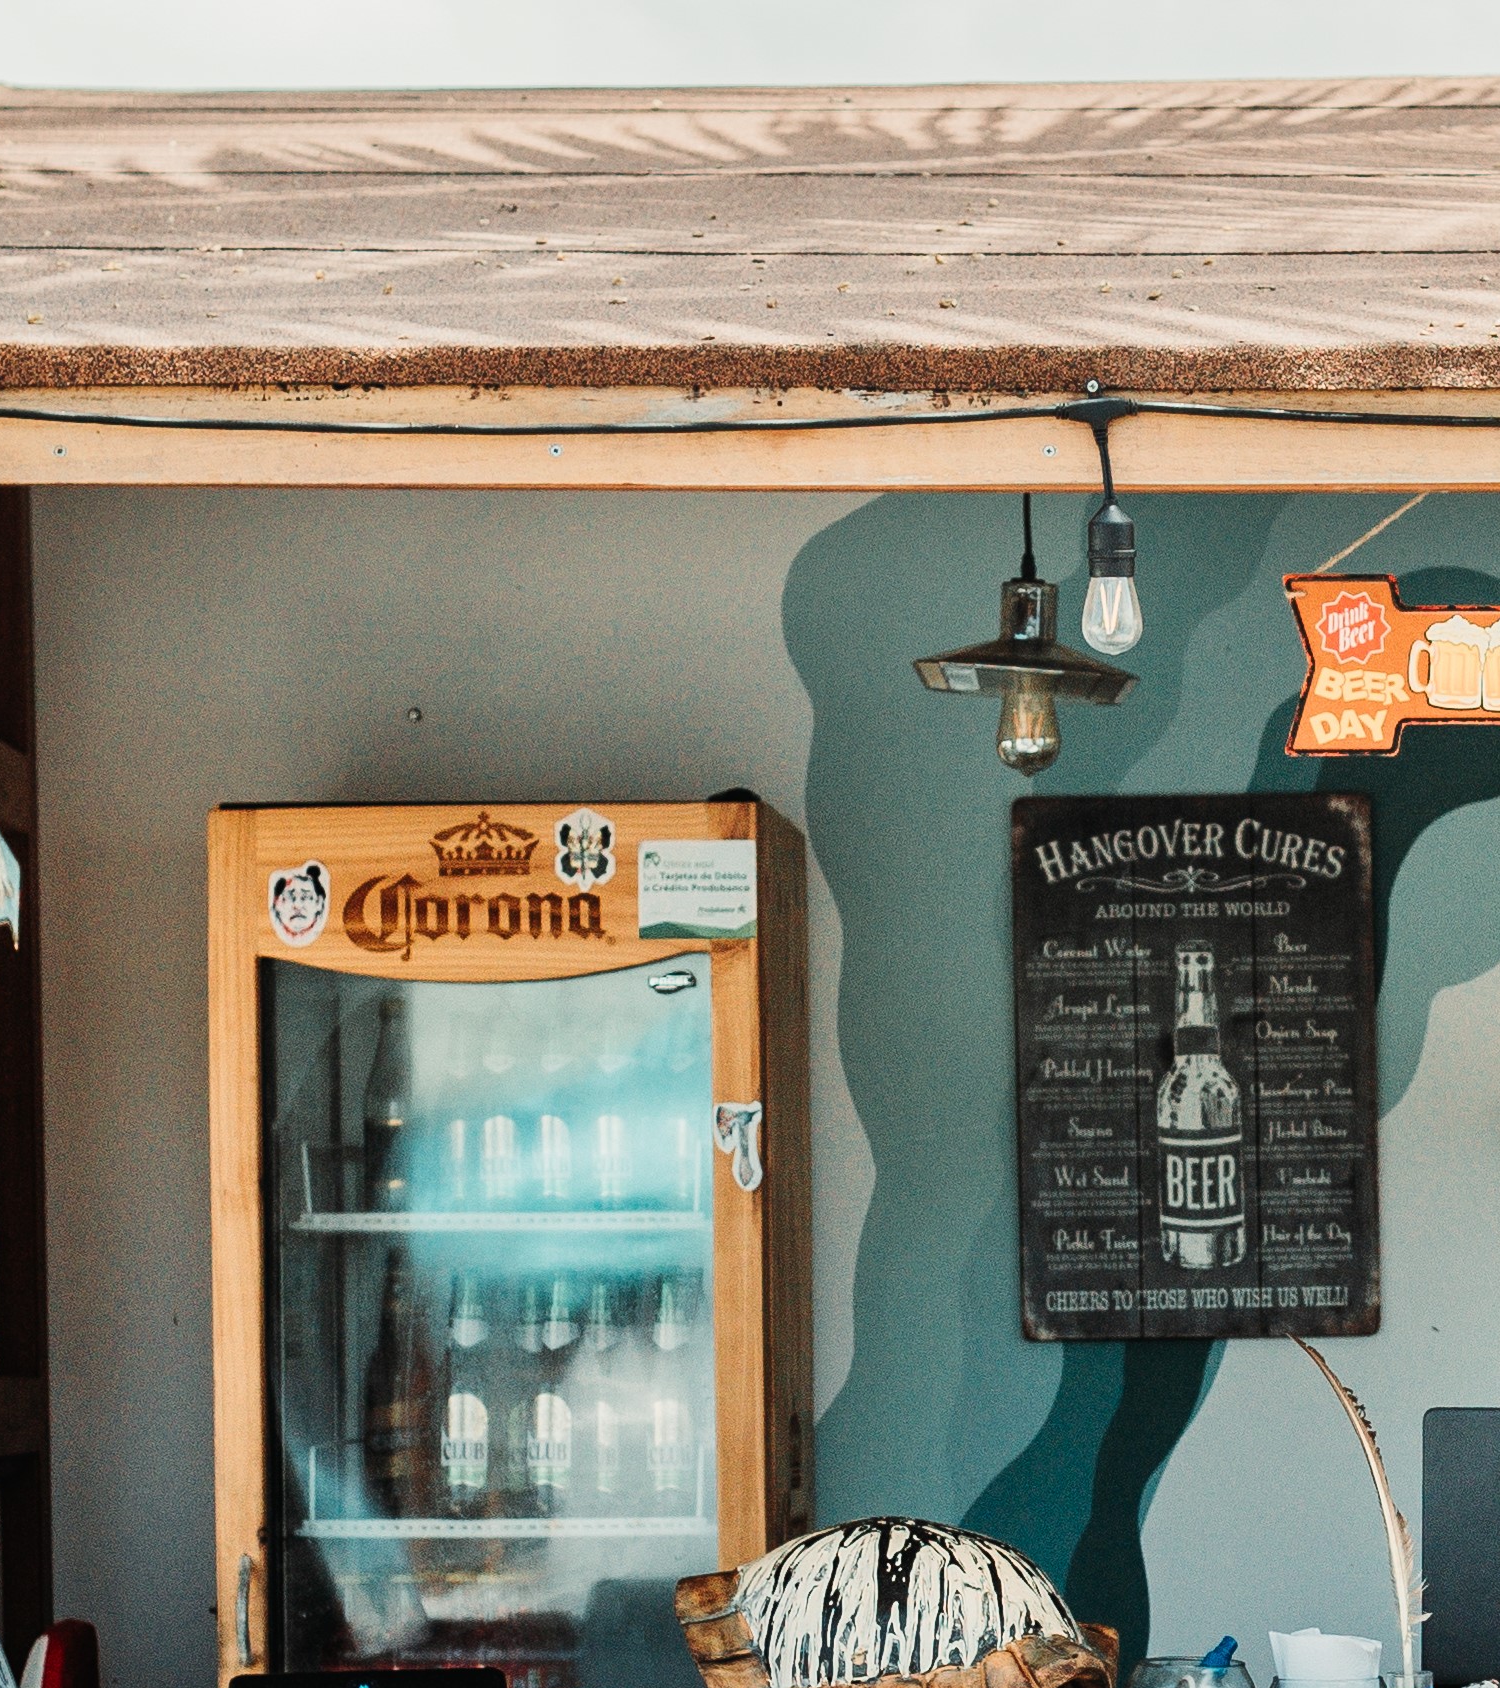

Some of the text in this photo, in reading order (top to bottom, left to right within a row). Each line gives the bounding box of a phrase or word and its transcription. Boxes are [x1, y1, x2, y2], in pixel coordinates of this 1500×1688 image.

[1327, 604, 1370, 635] Drink
[1338, 618, 1376, 653] Beer
[1314, 667, 1410, 705] BEER
[1309, 708, 1388, 745] DAY
[1035, 818, 1346, 883] HANGOVER CURES
[342, 871, 606, 961] Corona
[1095, 901, 1290, 920] AROUND THE WORLD
[1166, 1154, 1236, 1210] BEER
[1046, 1290, 1109, 1311] CHEERS
[1112, 1290, 1133, 1310] TO
[1136, 1289, 1187, 1310] THOSE
[1191, 1288, 1228, 1309] WHO
[1231, 1287, 1273, 1308] WISH
[1277, 1287, 1298, 1306] US
[443, 1442, 486, 1461] CLUB
[528, 1442, 568, 1461] CLUB
